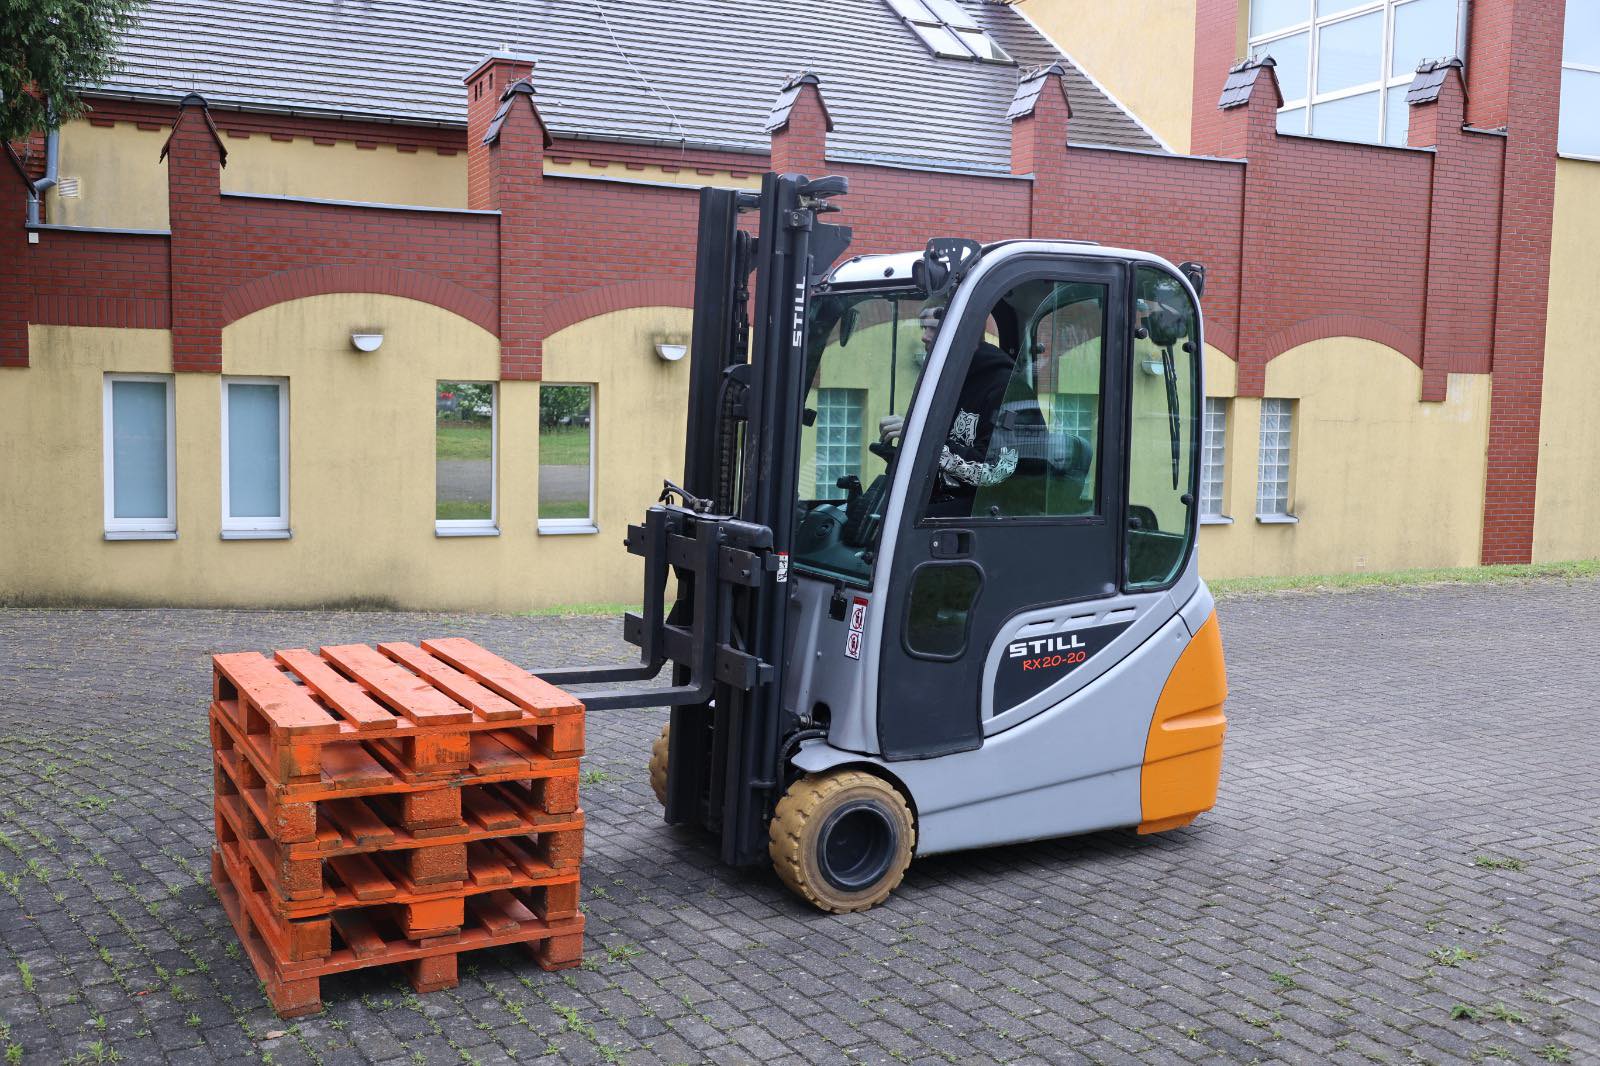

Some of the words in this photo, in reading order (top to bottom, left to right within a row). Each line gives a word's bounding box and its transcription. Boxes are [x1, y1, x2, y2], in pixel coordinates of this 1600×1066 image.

[792, 276, 805, 347] STILL
[1009, 634, 1085, 658] STILL
[1023, 651, 1086, 671] RX20-20
